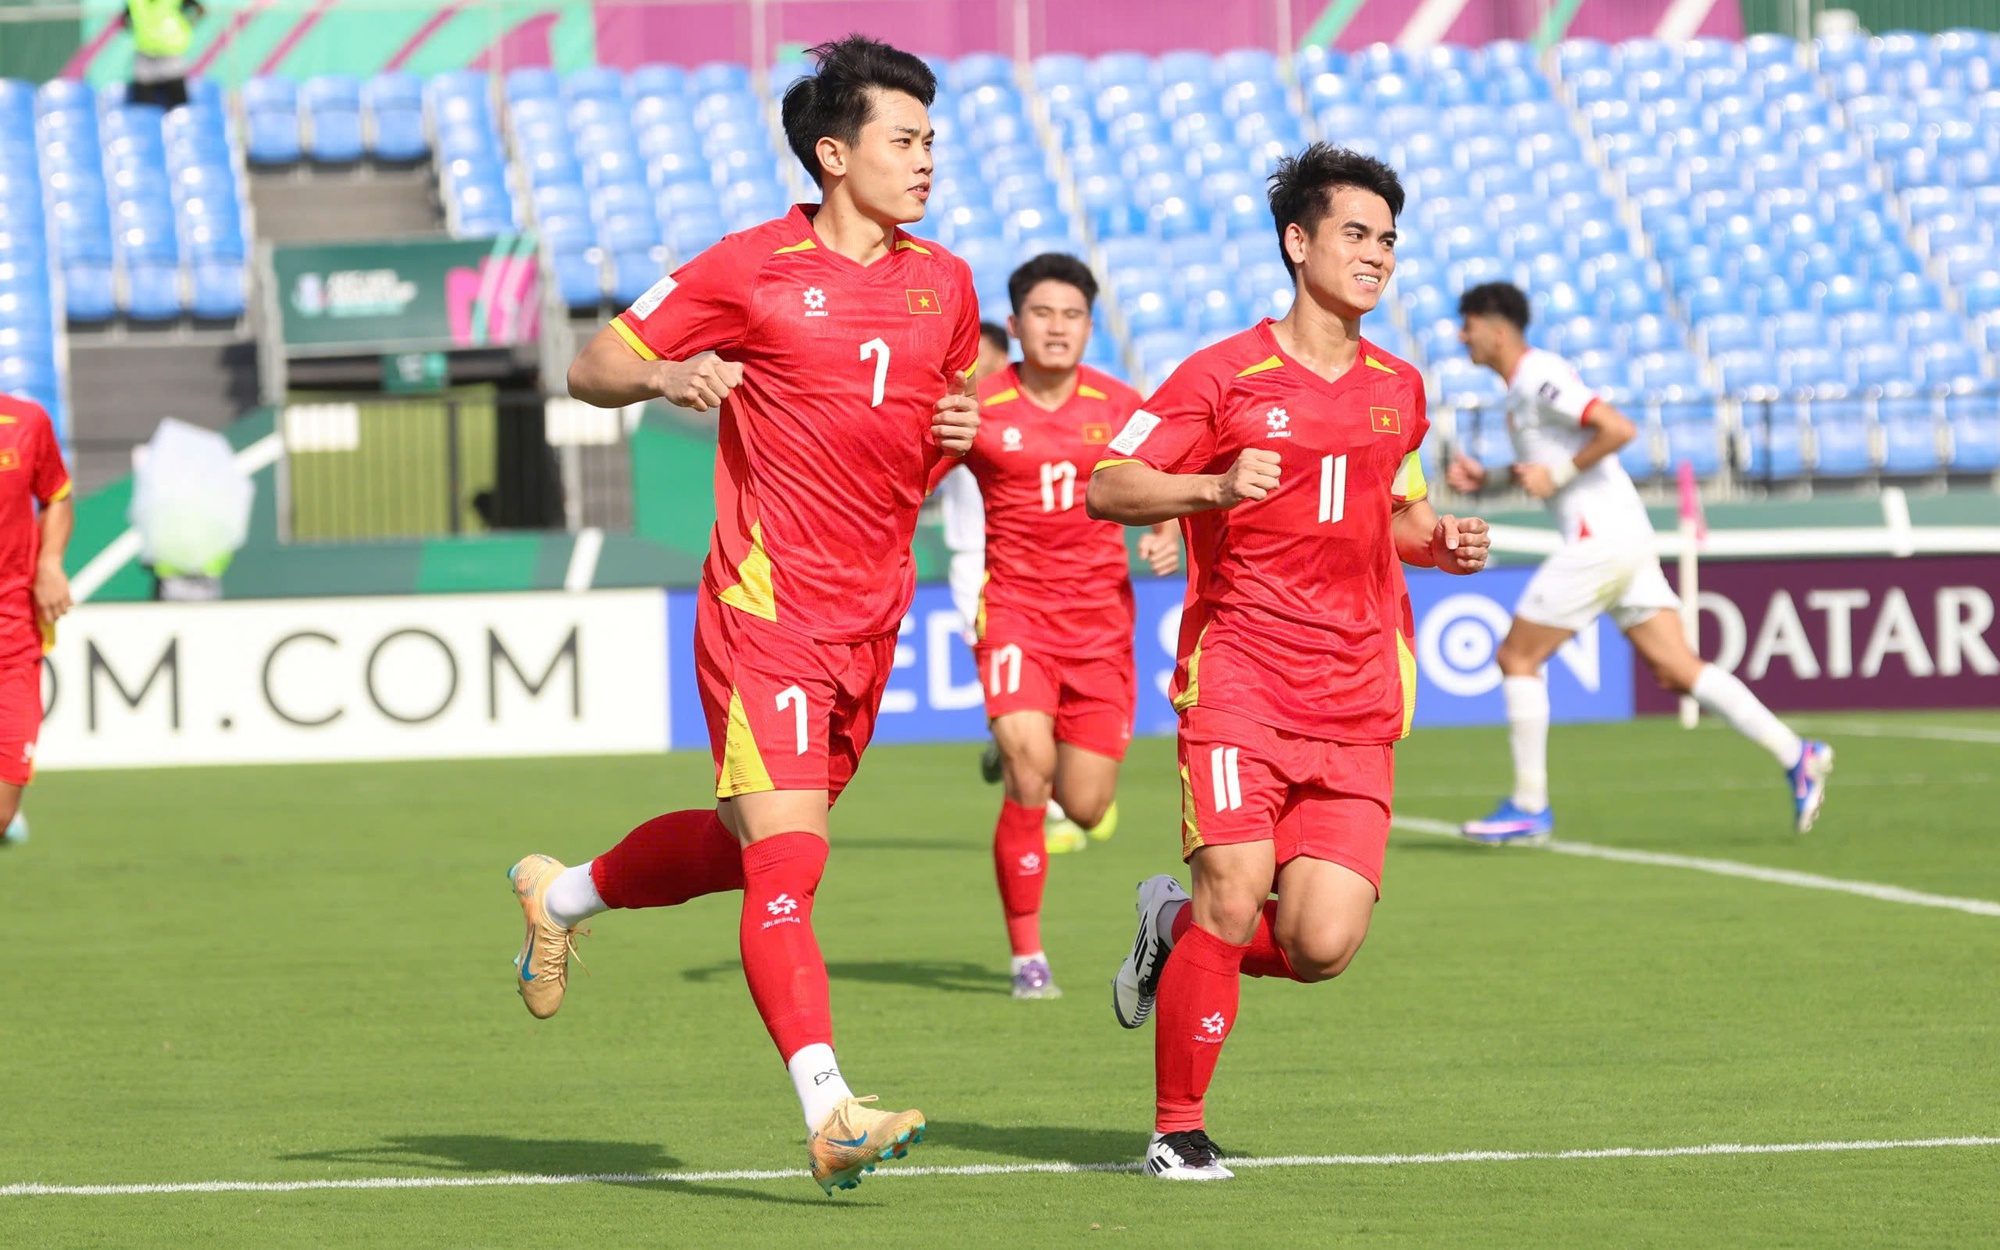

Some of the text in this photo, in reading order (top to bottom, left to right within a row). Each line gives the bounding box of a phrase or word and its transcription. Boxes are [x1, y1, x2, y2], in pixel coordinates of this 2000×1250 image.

[859, 336, 891, 408] 7
[1039, 460, 1078, 513] 17
[1318, 454, 1347, 524] 11
[989, 643, 1023, 697] 17
[774, 684, 809, 756] 7
[1210, 746, 1243, 813] 11
